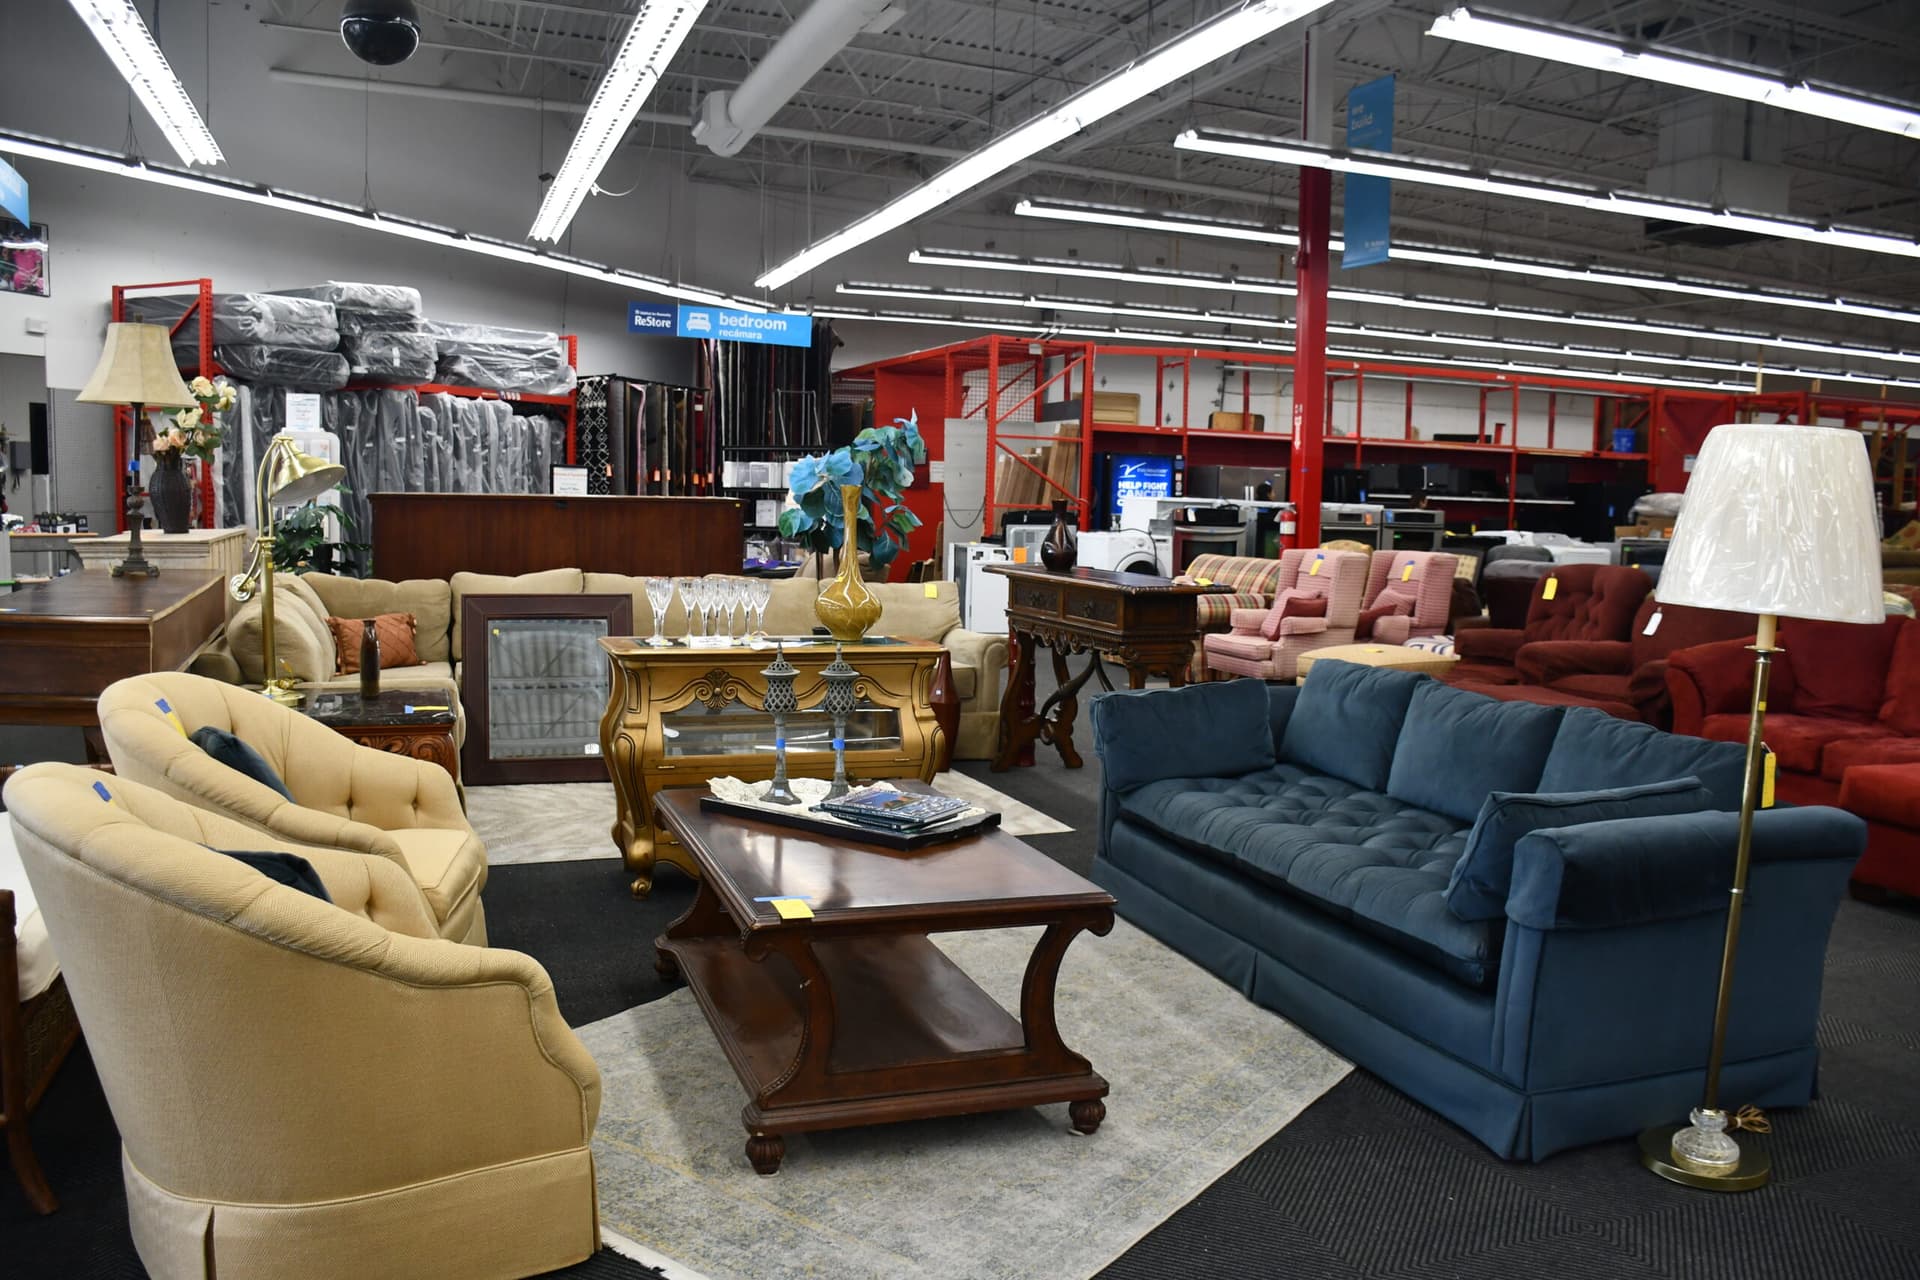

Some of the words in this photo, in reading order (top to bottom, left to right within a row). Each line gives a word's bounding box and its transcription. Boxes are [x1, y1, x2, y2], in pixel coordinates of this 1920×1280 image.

[634, 315, 672, 328] ReStore
[719, 311, 788, 331] bedroom
[719, 328, 763, 340] recámara
[1117, 480, 1142, 490] HELP
[1143, 481, 1168, 491] FIGHT
